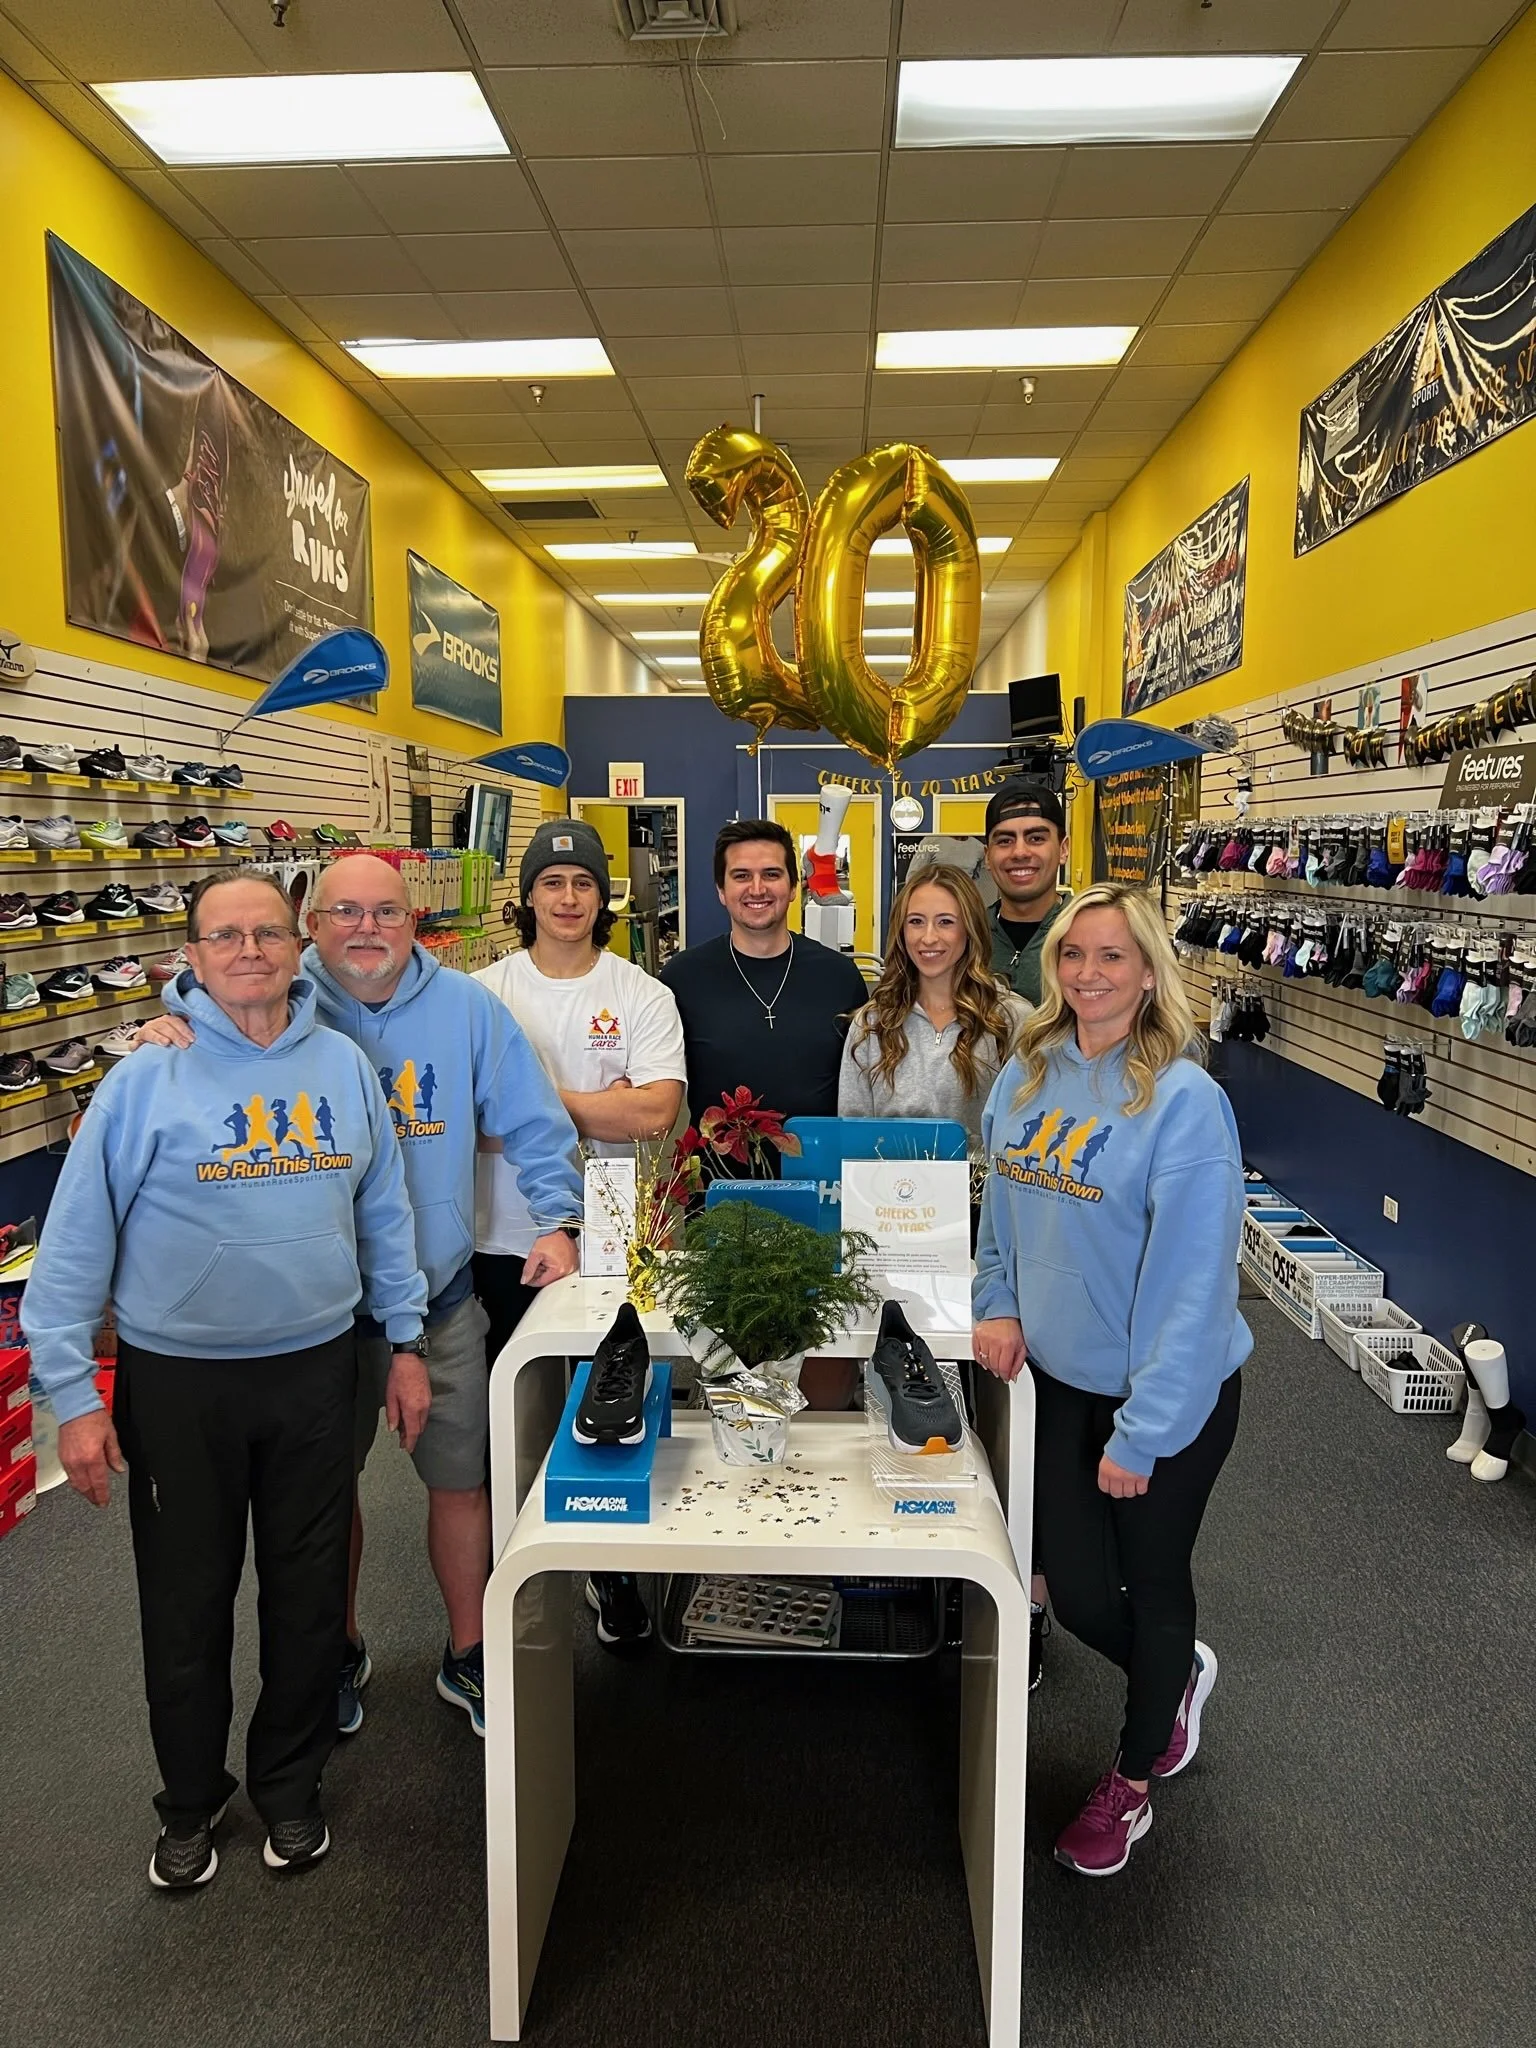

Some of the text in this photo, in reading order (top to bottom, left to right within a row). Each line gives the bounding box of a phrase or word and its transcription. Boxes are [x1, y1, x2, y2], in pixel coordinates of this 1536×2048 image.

[1411, 381, 1439, 408] SPORTS
[292, 519, 348, 593] RUNS
[684, 424, 982, 758] 20
[443, 631, 498, 683] BROOKS
[329, 662, 376, 676] BROOKS
[1112, 739, 1153, 757] BROOKS
[1458, 753, 1524, 782] feetures
[616, 778, 639, 796] EXIT
[818, 770, 1006, 797] CHEERS TO 20 YEARS
[897, 842, 940, 854] feetures
[407, 1120, 445, 1138] Town
[197, 1153, 352, 1182] We Run This Town
[996, 1158, 1104, 1203] We Run This Town
[875, 1206, 936, 1220] CHEERS TO
[877, 1221, 935, 1234] 20 YEARS
[1273, 1250, 1297, 1291] OS1st
[565, 1496, 627, 1511] HOKA ONE
[609, 1504, 628, 1512] ONE
[893, 1500, 956, 1514] HOKA ONE
[938, 1507, 957, 1515] ONE
